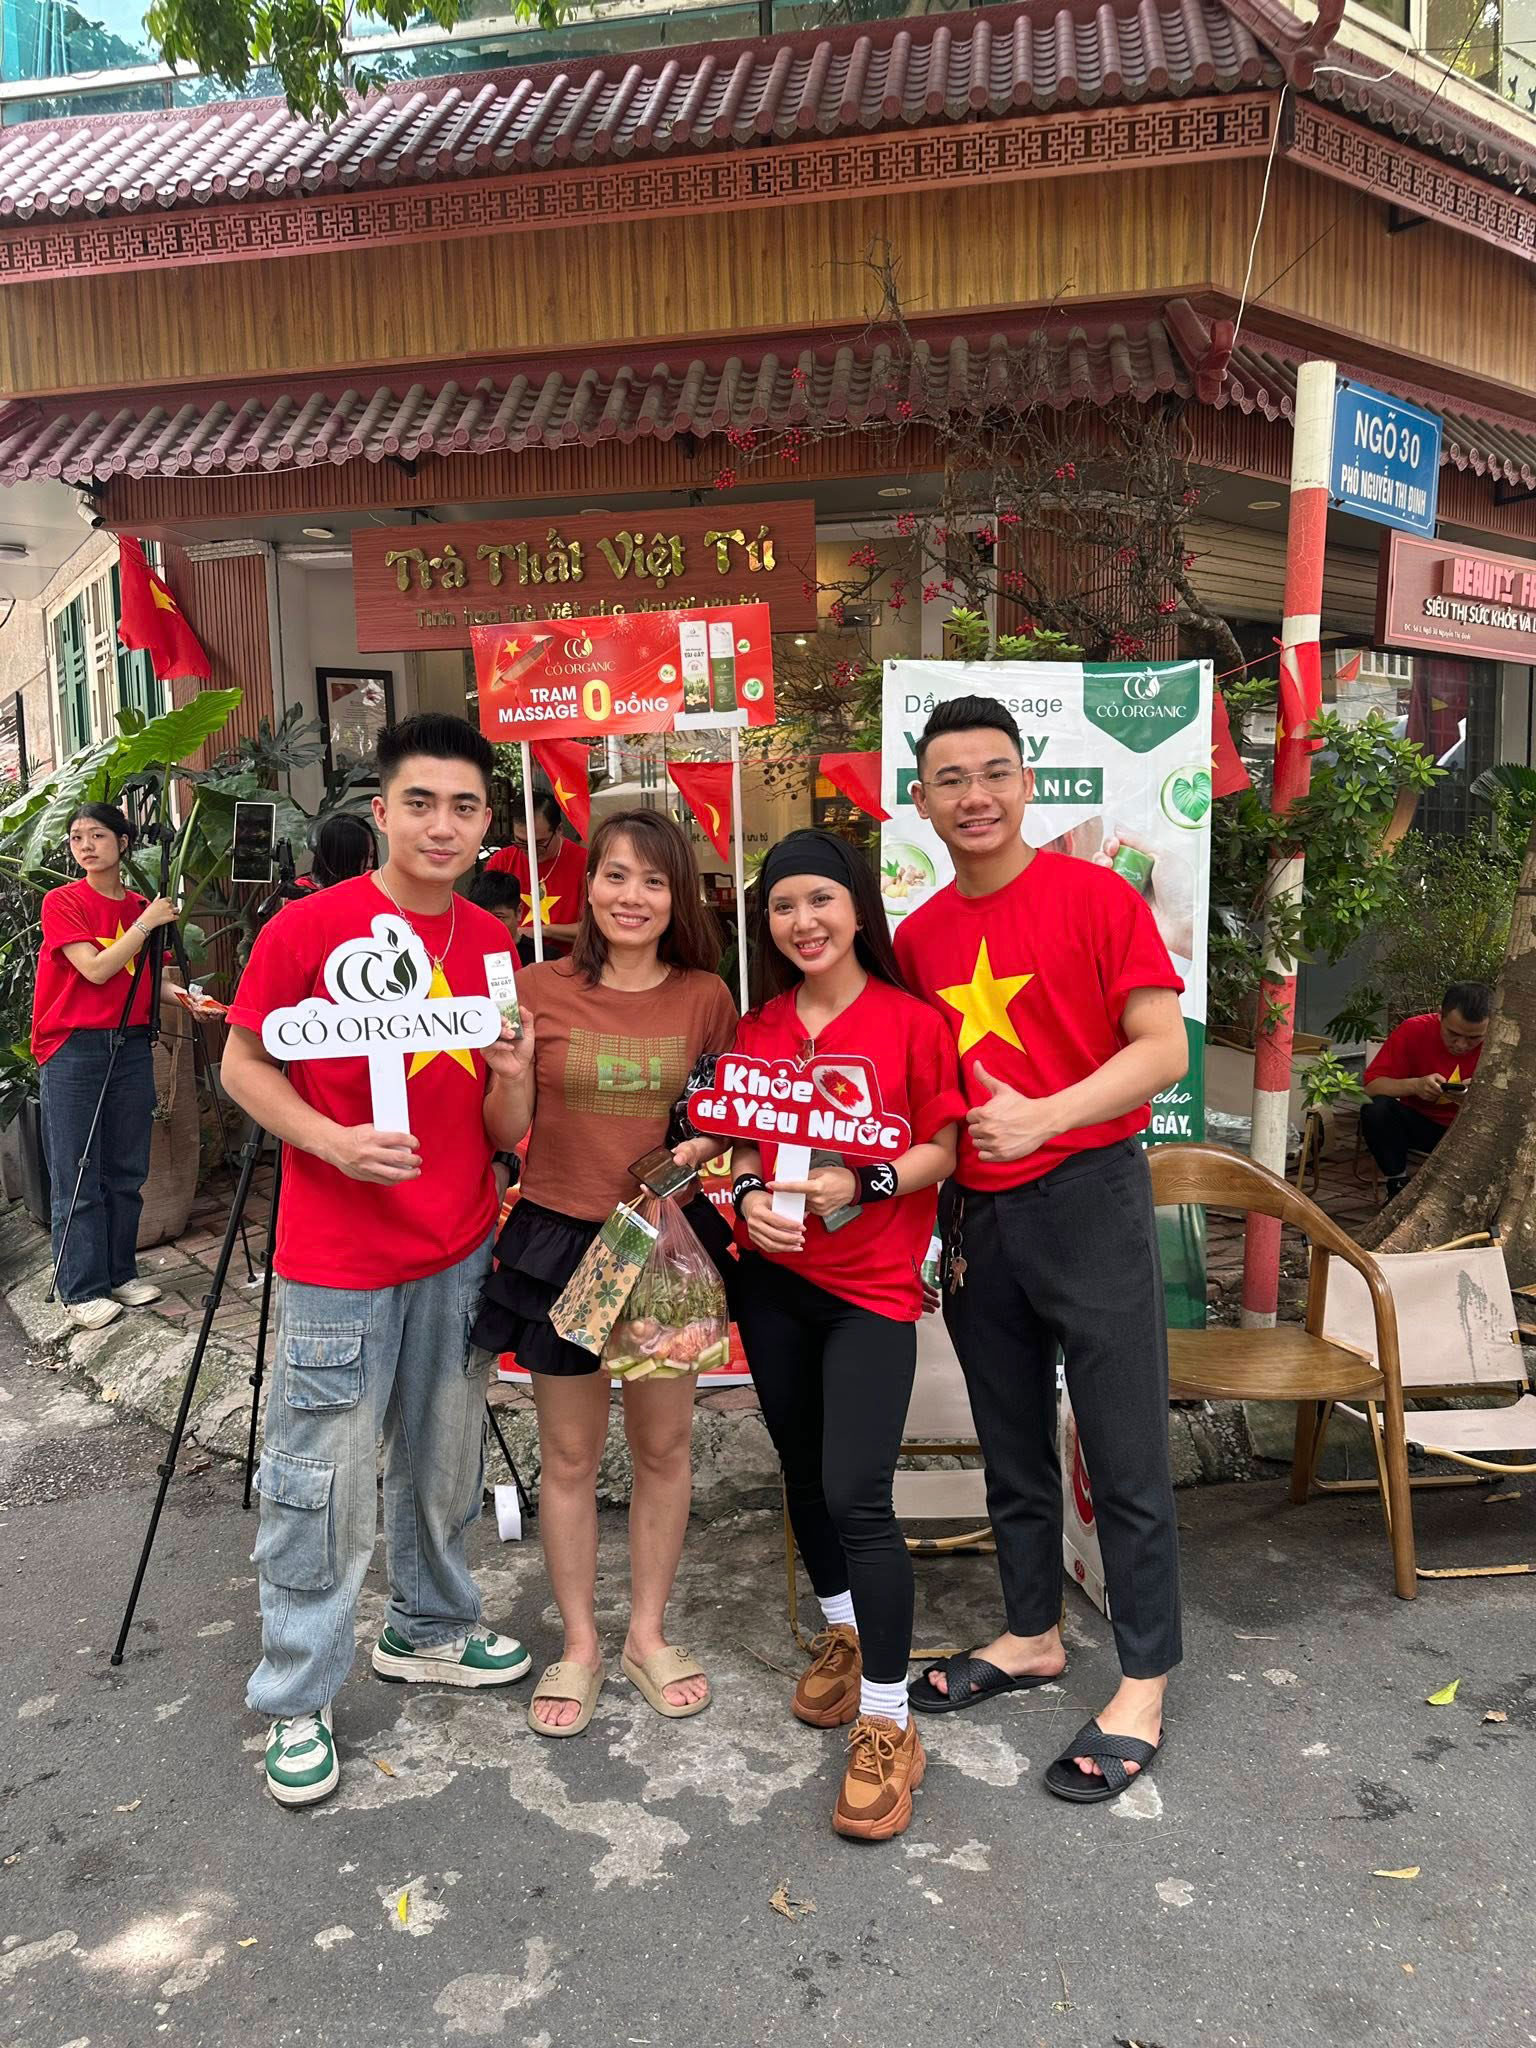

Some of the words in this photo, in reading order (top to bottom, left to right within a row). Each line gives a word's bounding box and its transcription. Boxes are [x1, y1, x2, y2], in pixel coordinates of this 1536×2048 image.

[1354, 410, 1397, 459] NGÕ
[1399, 428, 1420, 469] 30
[1340, 454, 1360, 496] PHỐ
[1360, 464, 1394, 506] NGUYỄN
[1394, 481, 1408, 517] THỊ
[1407, 485, 1427, 520] ĐỊNH
[385, 544, 467, 592] Trà
[476, 528, 584, 586] Thất
[596, 530, 685, 588] Việt
[703, 525, 776, 575] Tú
[1453, 557, 1515, 604] BEAUTY
[416, 608, 456, 627] Tinh
[507, 604, 536, 621] Trà
[1425, 596, 1449, 618] SIÊU
[1451, 603, 1468, 626] THỊ
[1468, 603, 1490, 625] SỨC
[1491, 606, 1517, 630] KHỎE
[1519, 612, 1531, 632] VÀ
[564, 661, 616, 675] ORGANIC
[498, 703, 579, 723] MASSAGE
[583, 679, 612, 722] 0
[614, 691, 669, 715] ĐỒNG
[530, 686, 577, 706] TRẠM
[905, 692, 950, 713] Dầ
[1001, 697, 1063, 718] ssage
[1121, 704, 1187, 718] ORGANIC
[277, 1009, 328, 1046] CỎ
[336, 1010, 483, 1042] ORGANIC
[723, 1063, 814, 1103] Khỏe
[1152, 1083, 1192, 1104] cho
[697, 1096, 728, 1120] để
[732, 1098, 799, 1134] Yêu
[808, 1109, 901, 1149] Nước
[1152, 1110, 1192, 1137] GÁY,
